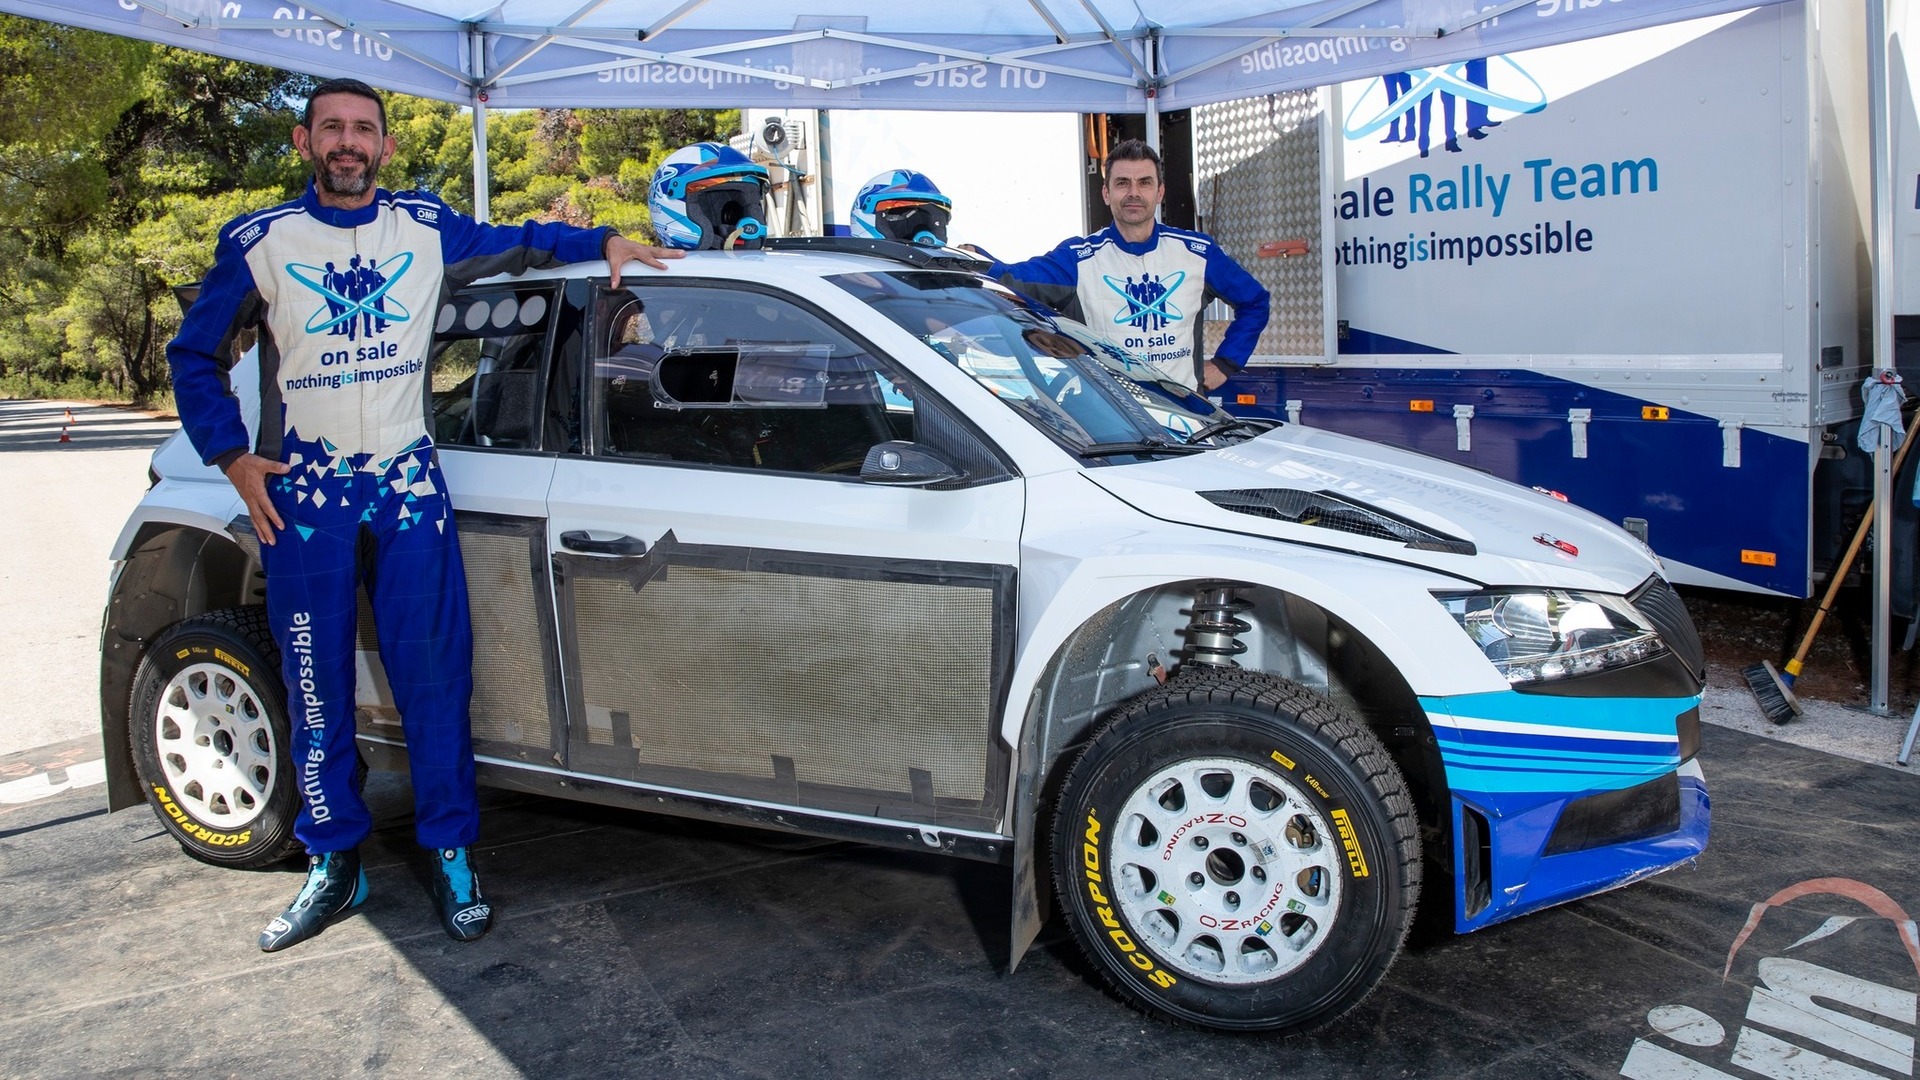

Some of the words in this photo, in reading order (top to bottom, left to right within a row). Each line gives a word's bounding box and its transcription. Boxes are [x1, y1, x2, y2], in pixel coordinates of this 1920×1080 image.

[1409, 164, 1511, 217] Rally
[1524, 157, 1658, 203] Team
[418, 210, 438, 221] OMP
[239, 225, 262, 245] OMP
[321, 350, 349, 366] on
[356, 341, 398, 362] sale
[1124, 337, 1144, 348] on
[1148, 333, 1176, 347] sale
[286, 358, 423, 391] nothingisimpossible
[215, 648, 250, 677] PIRELLI
[154, 786, 252, 847] SCORPION
[1163, 815, 1205, 861] RACING
[1331, 808, 1369, 878] PIRELLI
[457, 907, 491, 923] OMP
[1084, 815, 1177, 989] SCORPION
[1241, 882, 1284, 929] RACING
